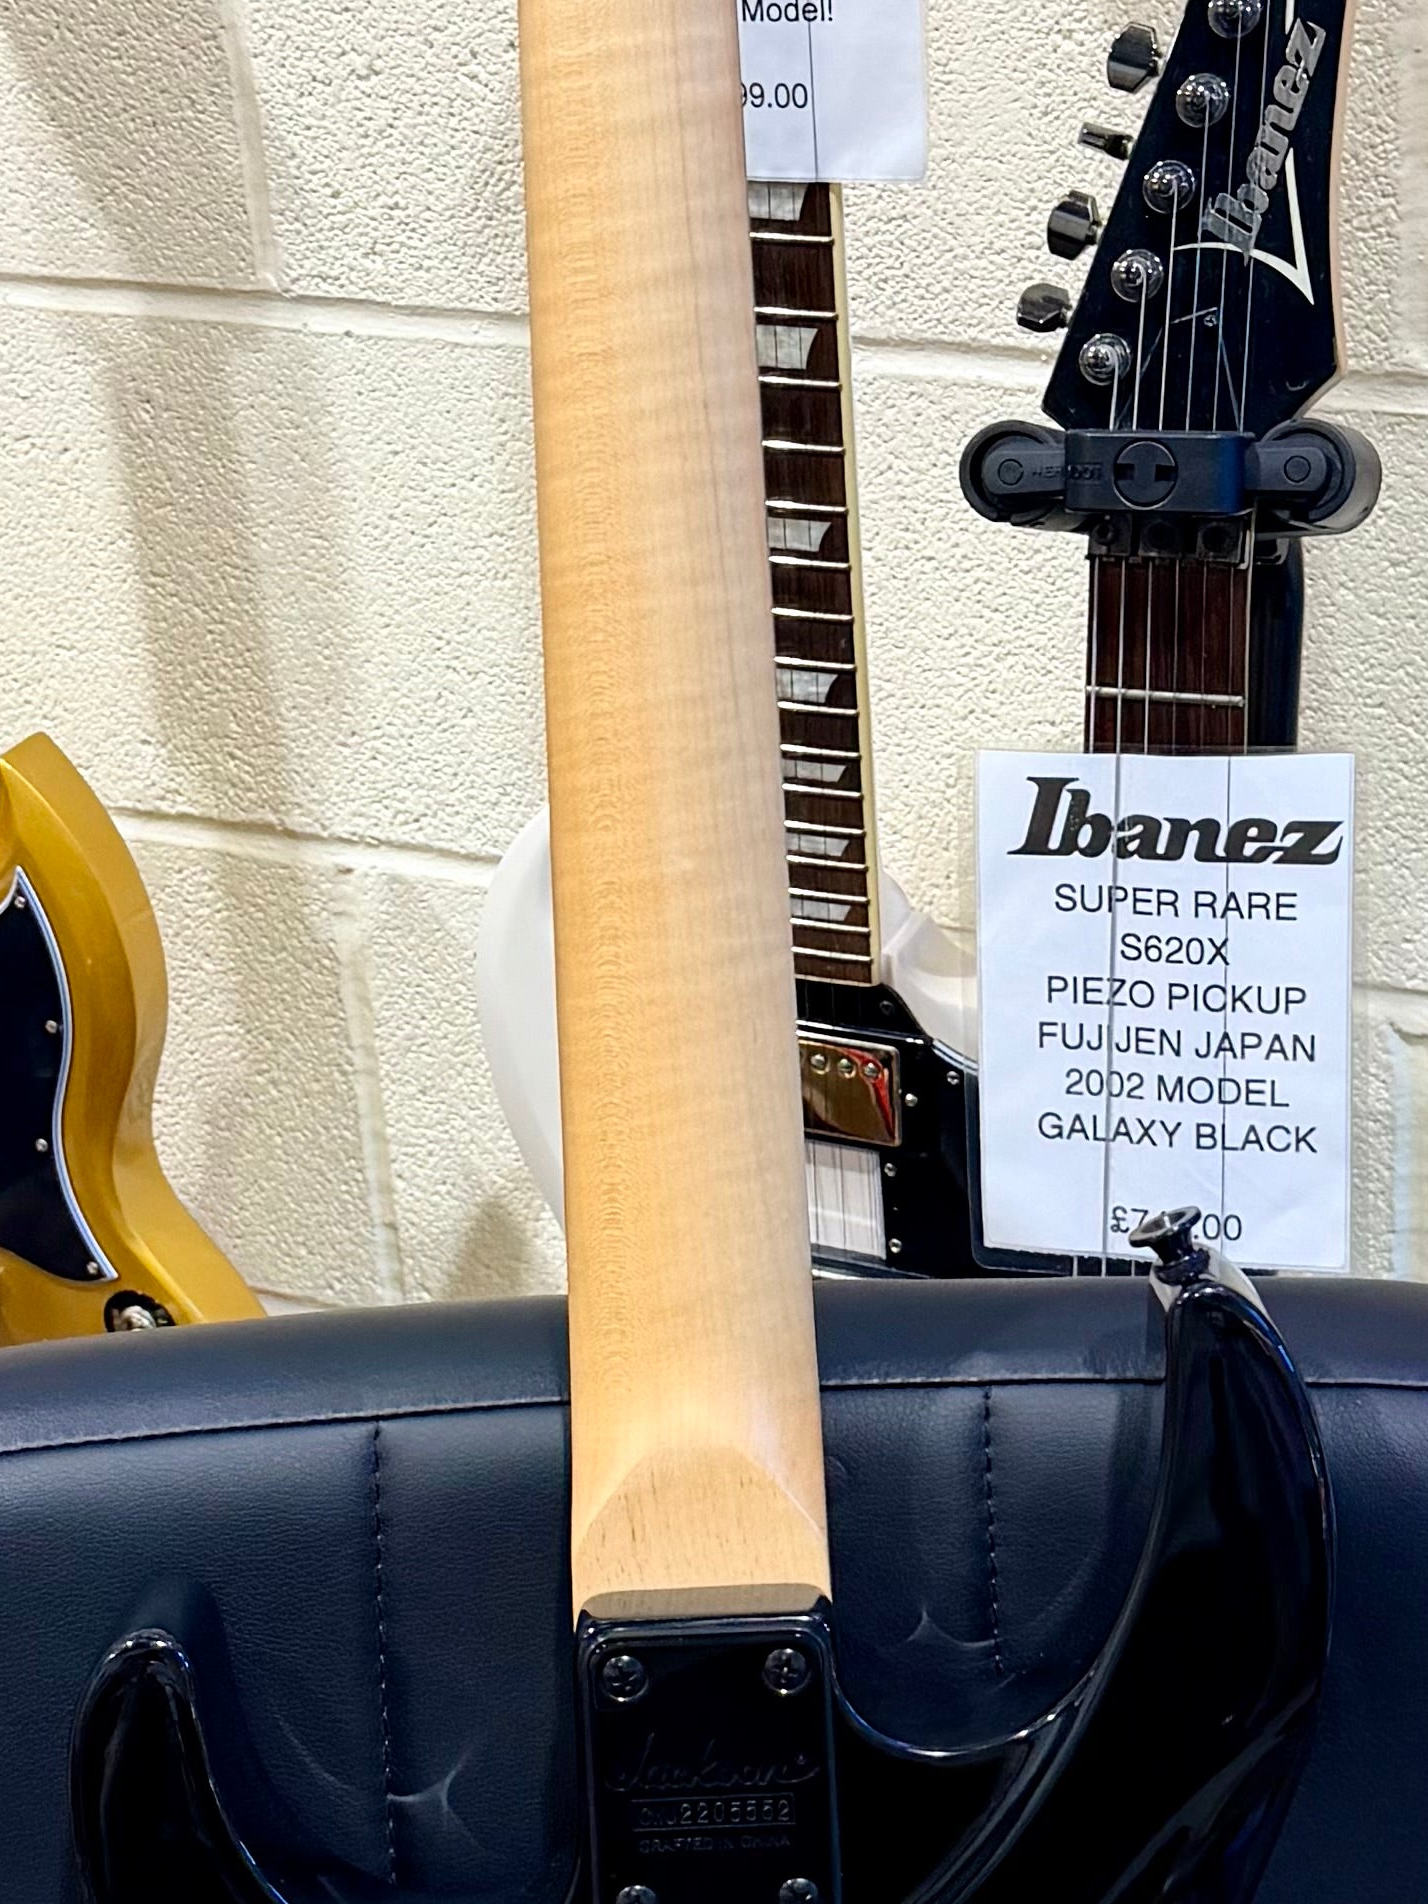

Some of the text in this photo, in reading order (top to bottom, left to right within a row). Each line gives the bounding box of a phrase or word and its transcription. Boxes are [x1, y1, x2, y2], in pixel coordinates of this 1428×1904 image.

[1201, 17, 1327, 266] Ibanez
[1007, 777, 1345, 865] Ibanez
[1054, 883, 1298, 921] SUPER RARE
[1119, 933, 1230, 966] S620X
[1047, 976, 1307, 1015] PIEZO PICKUP
[1039, 1021, 1316, 1062] FUJJEN JAPAN
[1065, 1069, 1290, 1108] 2002 MODEL
[1038, 1112, 1318, 1153] GALAXY BLACK
[1110, 1206, 1242, 1241] £7.00
